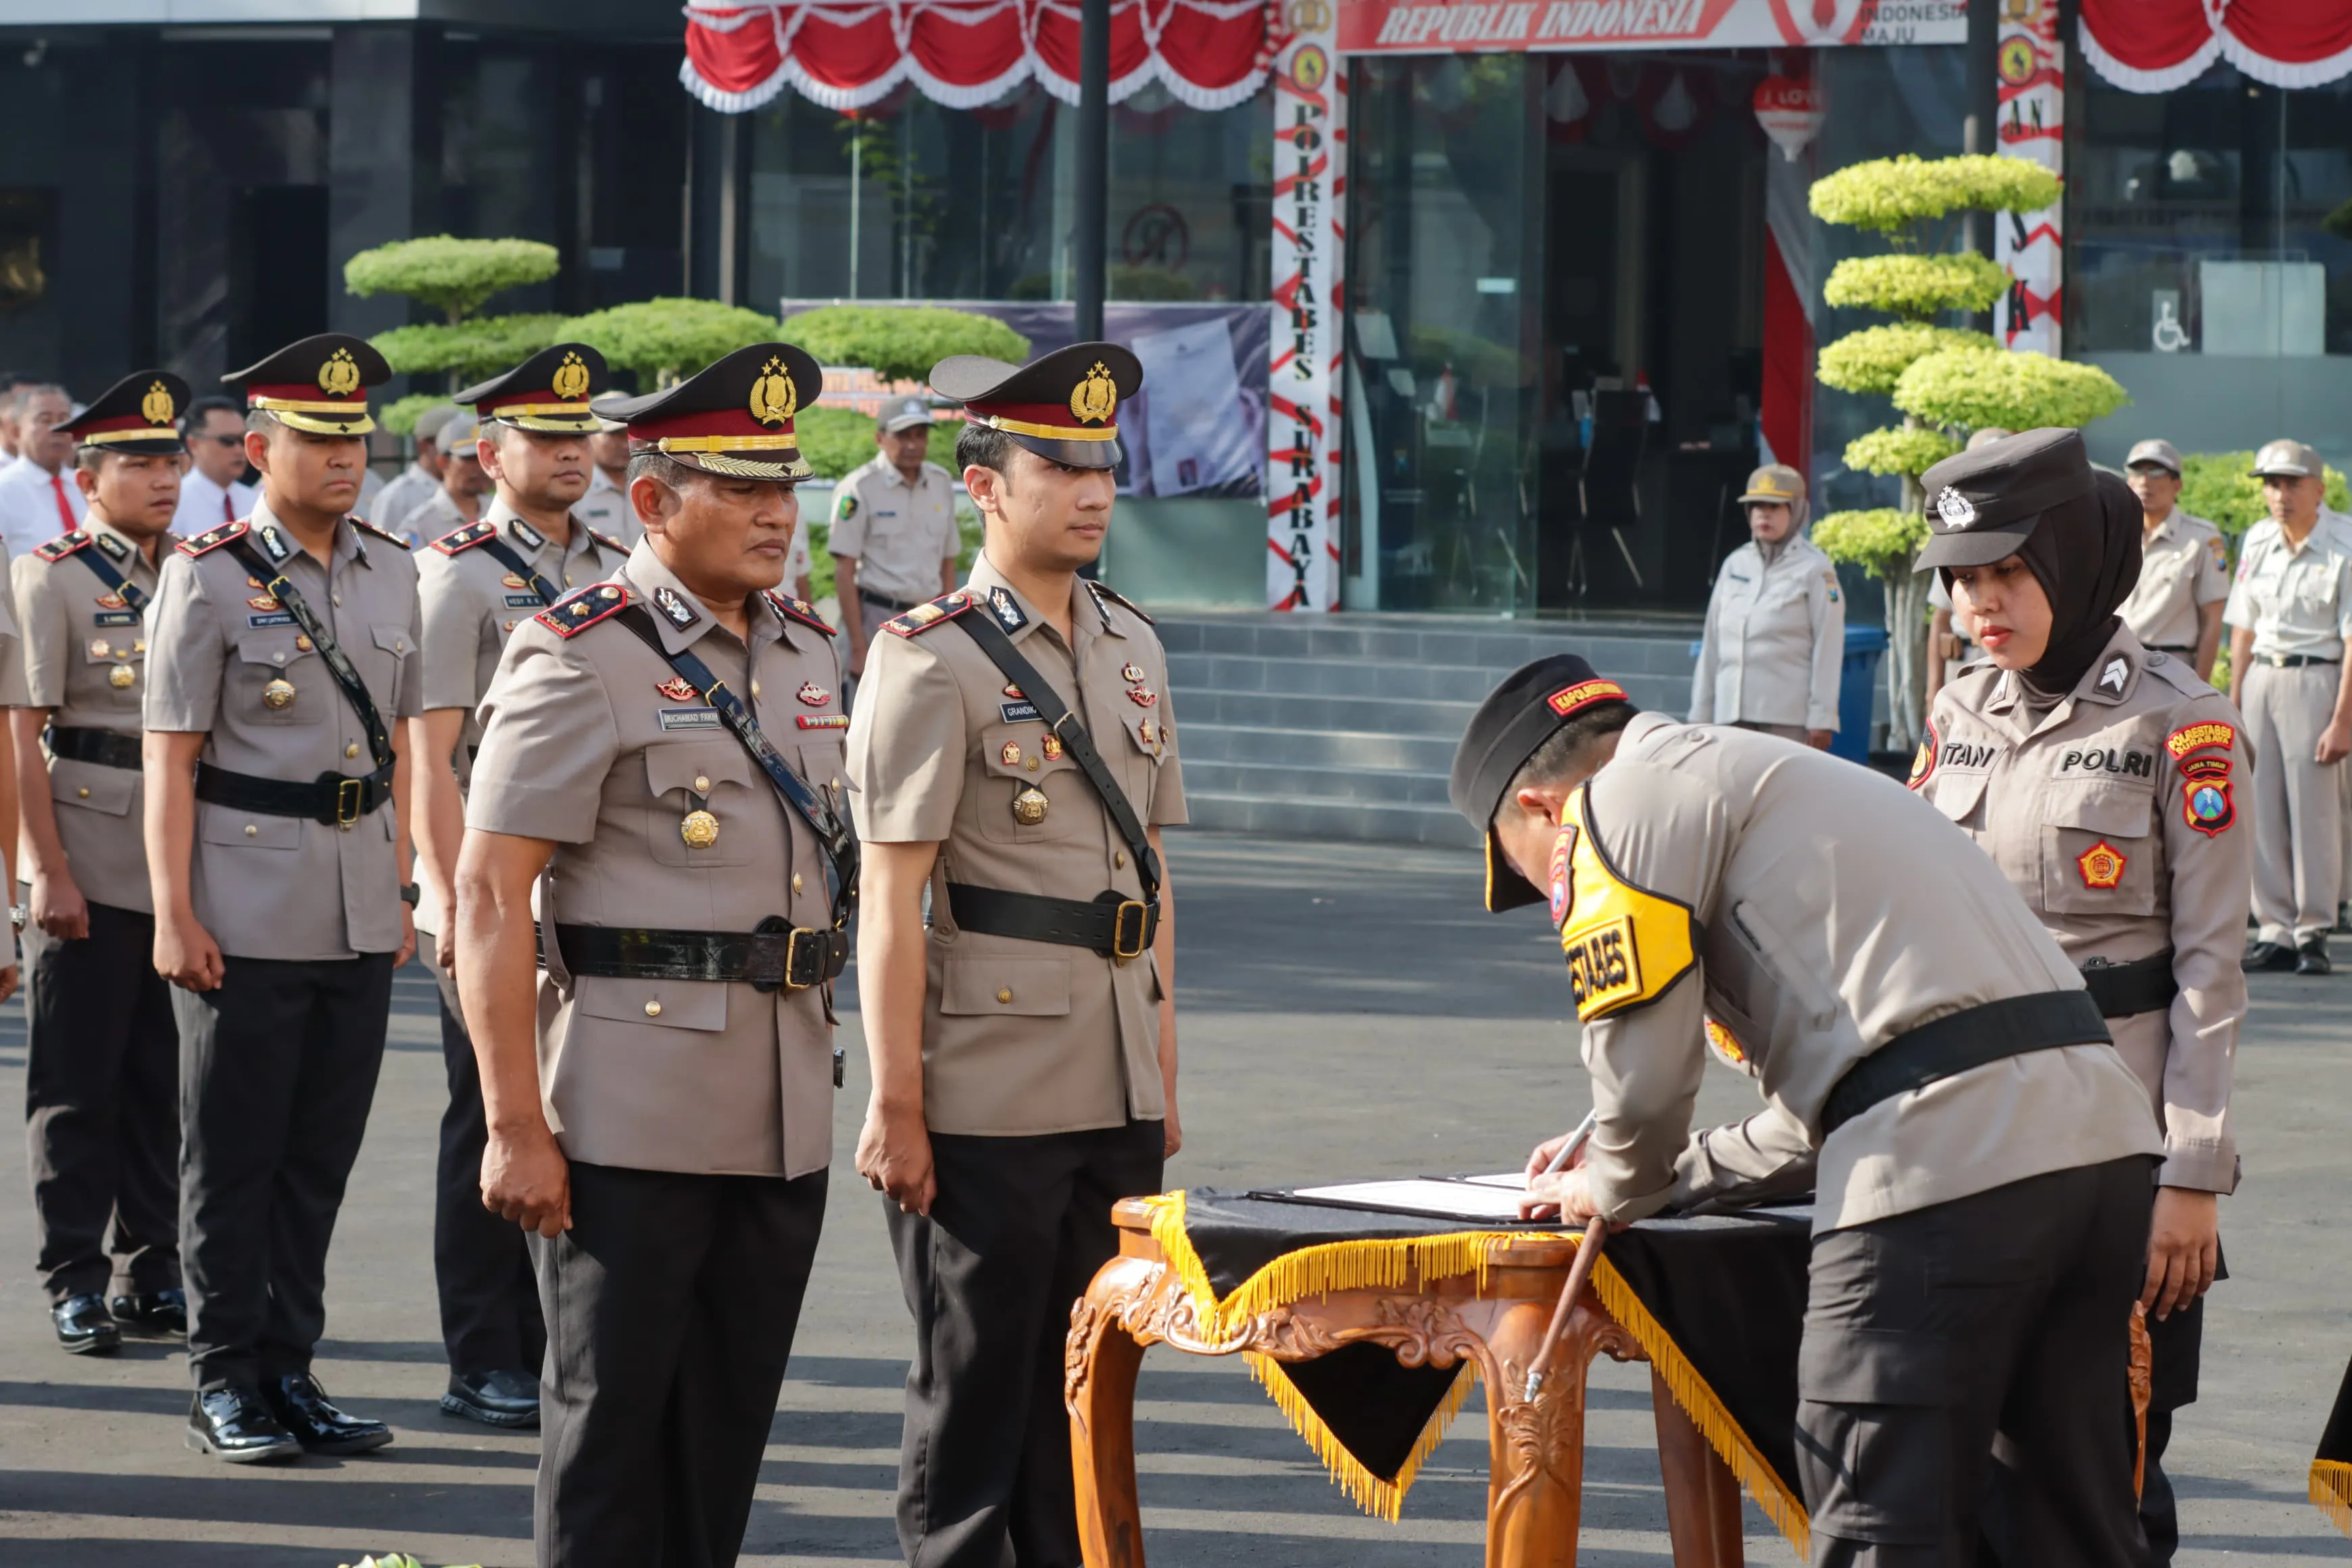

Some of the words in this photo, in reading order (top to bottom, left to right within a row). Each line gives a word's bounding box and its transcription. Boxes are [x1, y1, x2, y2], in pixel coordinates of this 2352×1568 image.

[1376, 3, 1535, 44] REPUBLIK
[1537, 0, 1705, 38] INDONESIA
[1861, 3, 1969, 22] INDONESIA
[1861, 26, 1915, 43] MAJU
[1292, 103, 1323, 381] POLRESTABES
[1290, 406, 1314, 606] SURABAYA
[2167, 725, 2232, 751] POLRESTABES
[2175, 735, 2230, 755] SURABAYA
[2062, 748, 2152, 777] POLRI
[2187, 761, 2205, 772] JAWA
[2205, 760, 2227, 770] TIMUR
